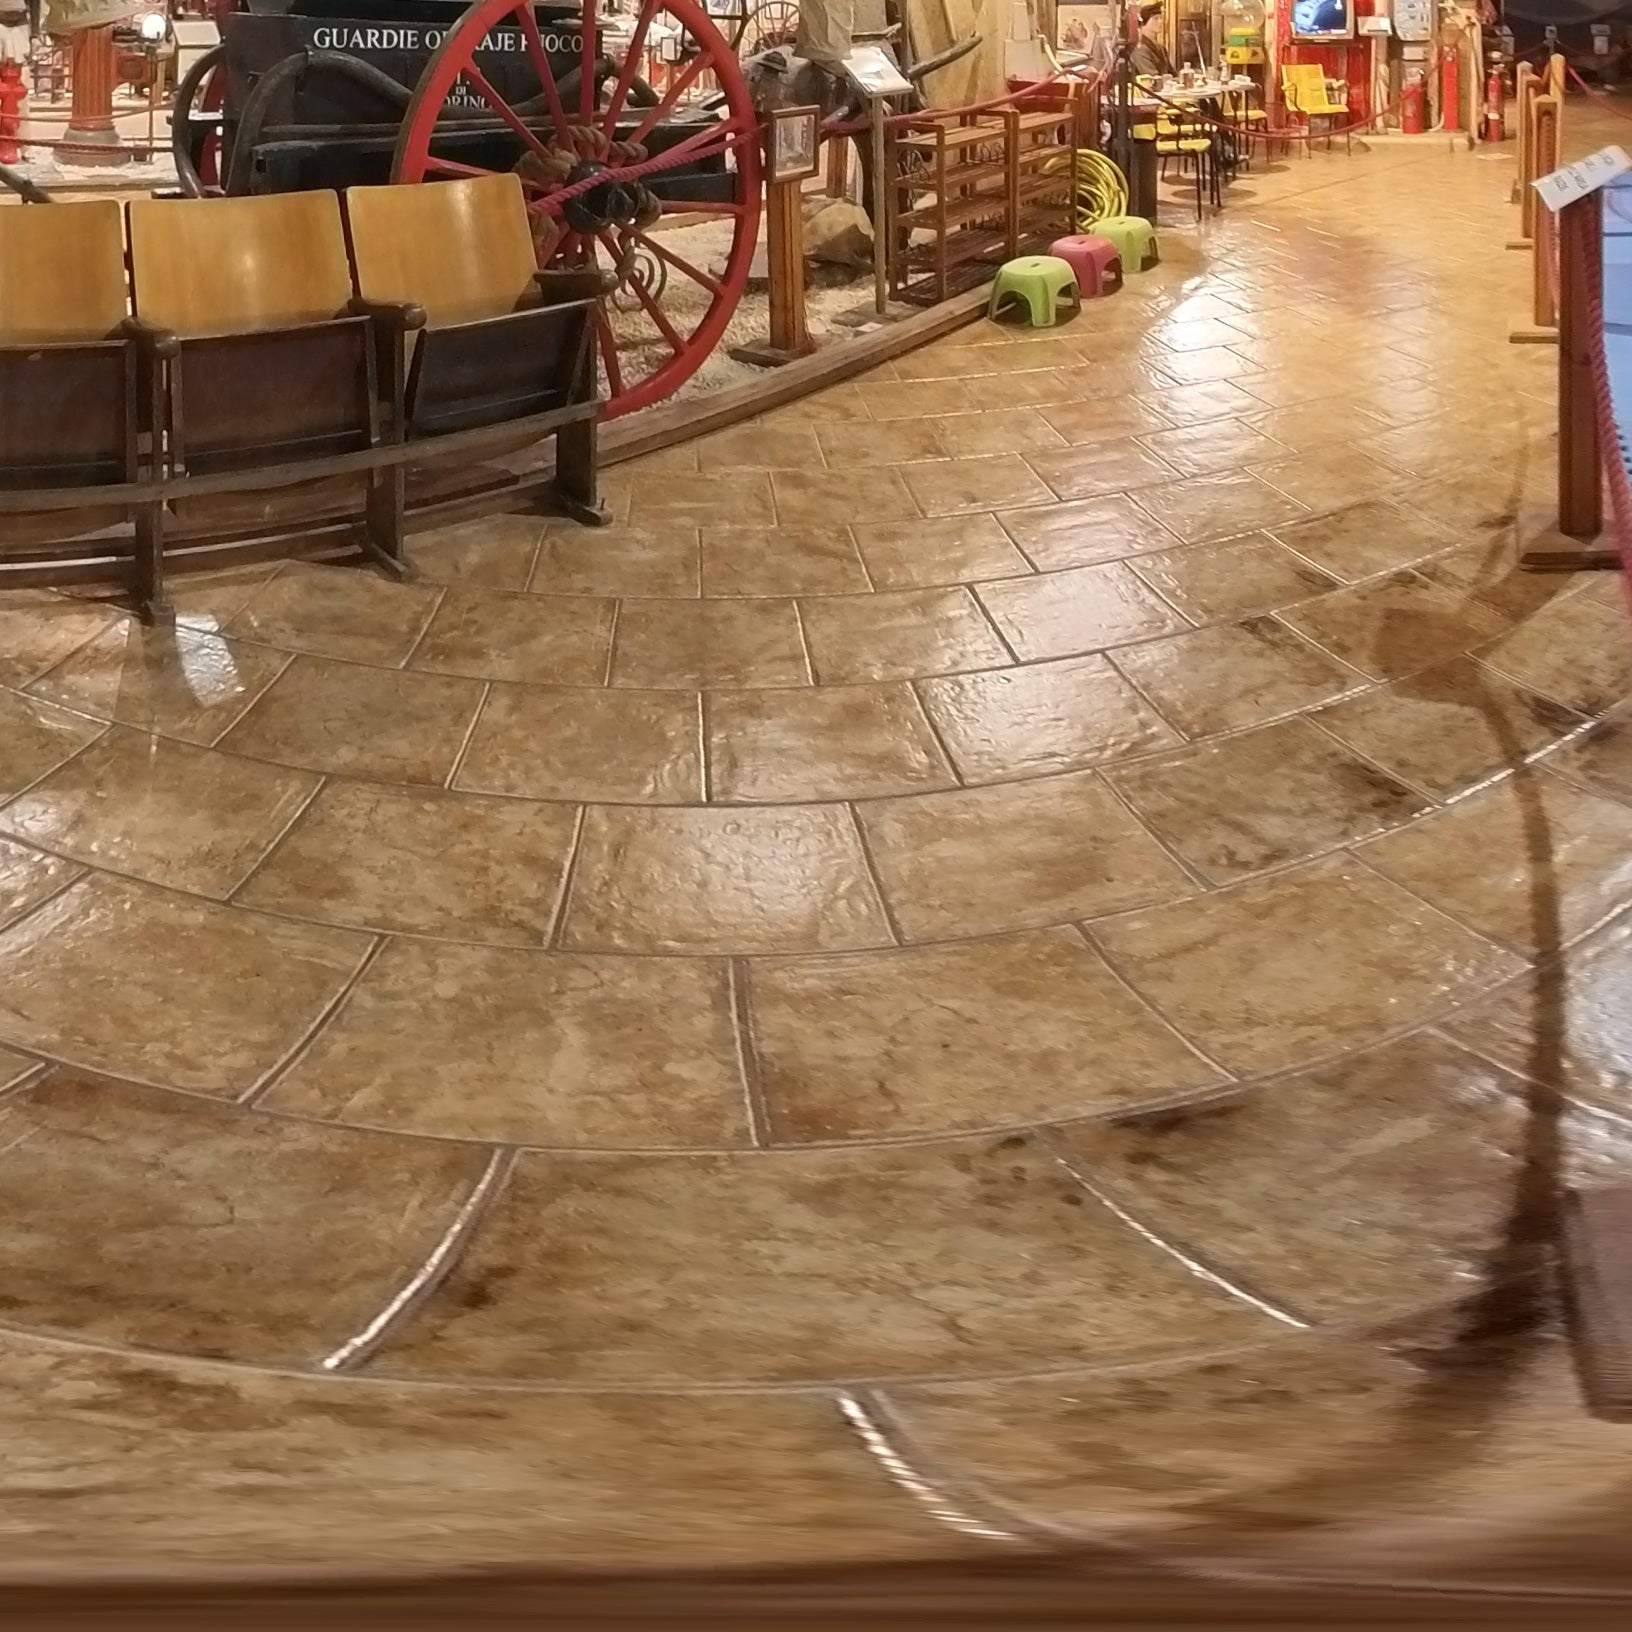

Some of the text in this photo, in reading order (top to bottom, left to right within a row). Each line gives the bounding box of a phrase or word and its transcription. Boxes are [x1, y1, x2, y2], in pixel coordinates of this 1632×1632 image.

[313, 27, 420, 49] GUARDIE
[425, 30, 516, 52] OAJE
[456, 85, 467, 95] DI
